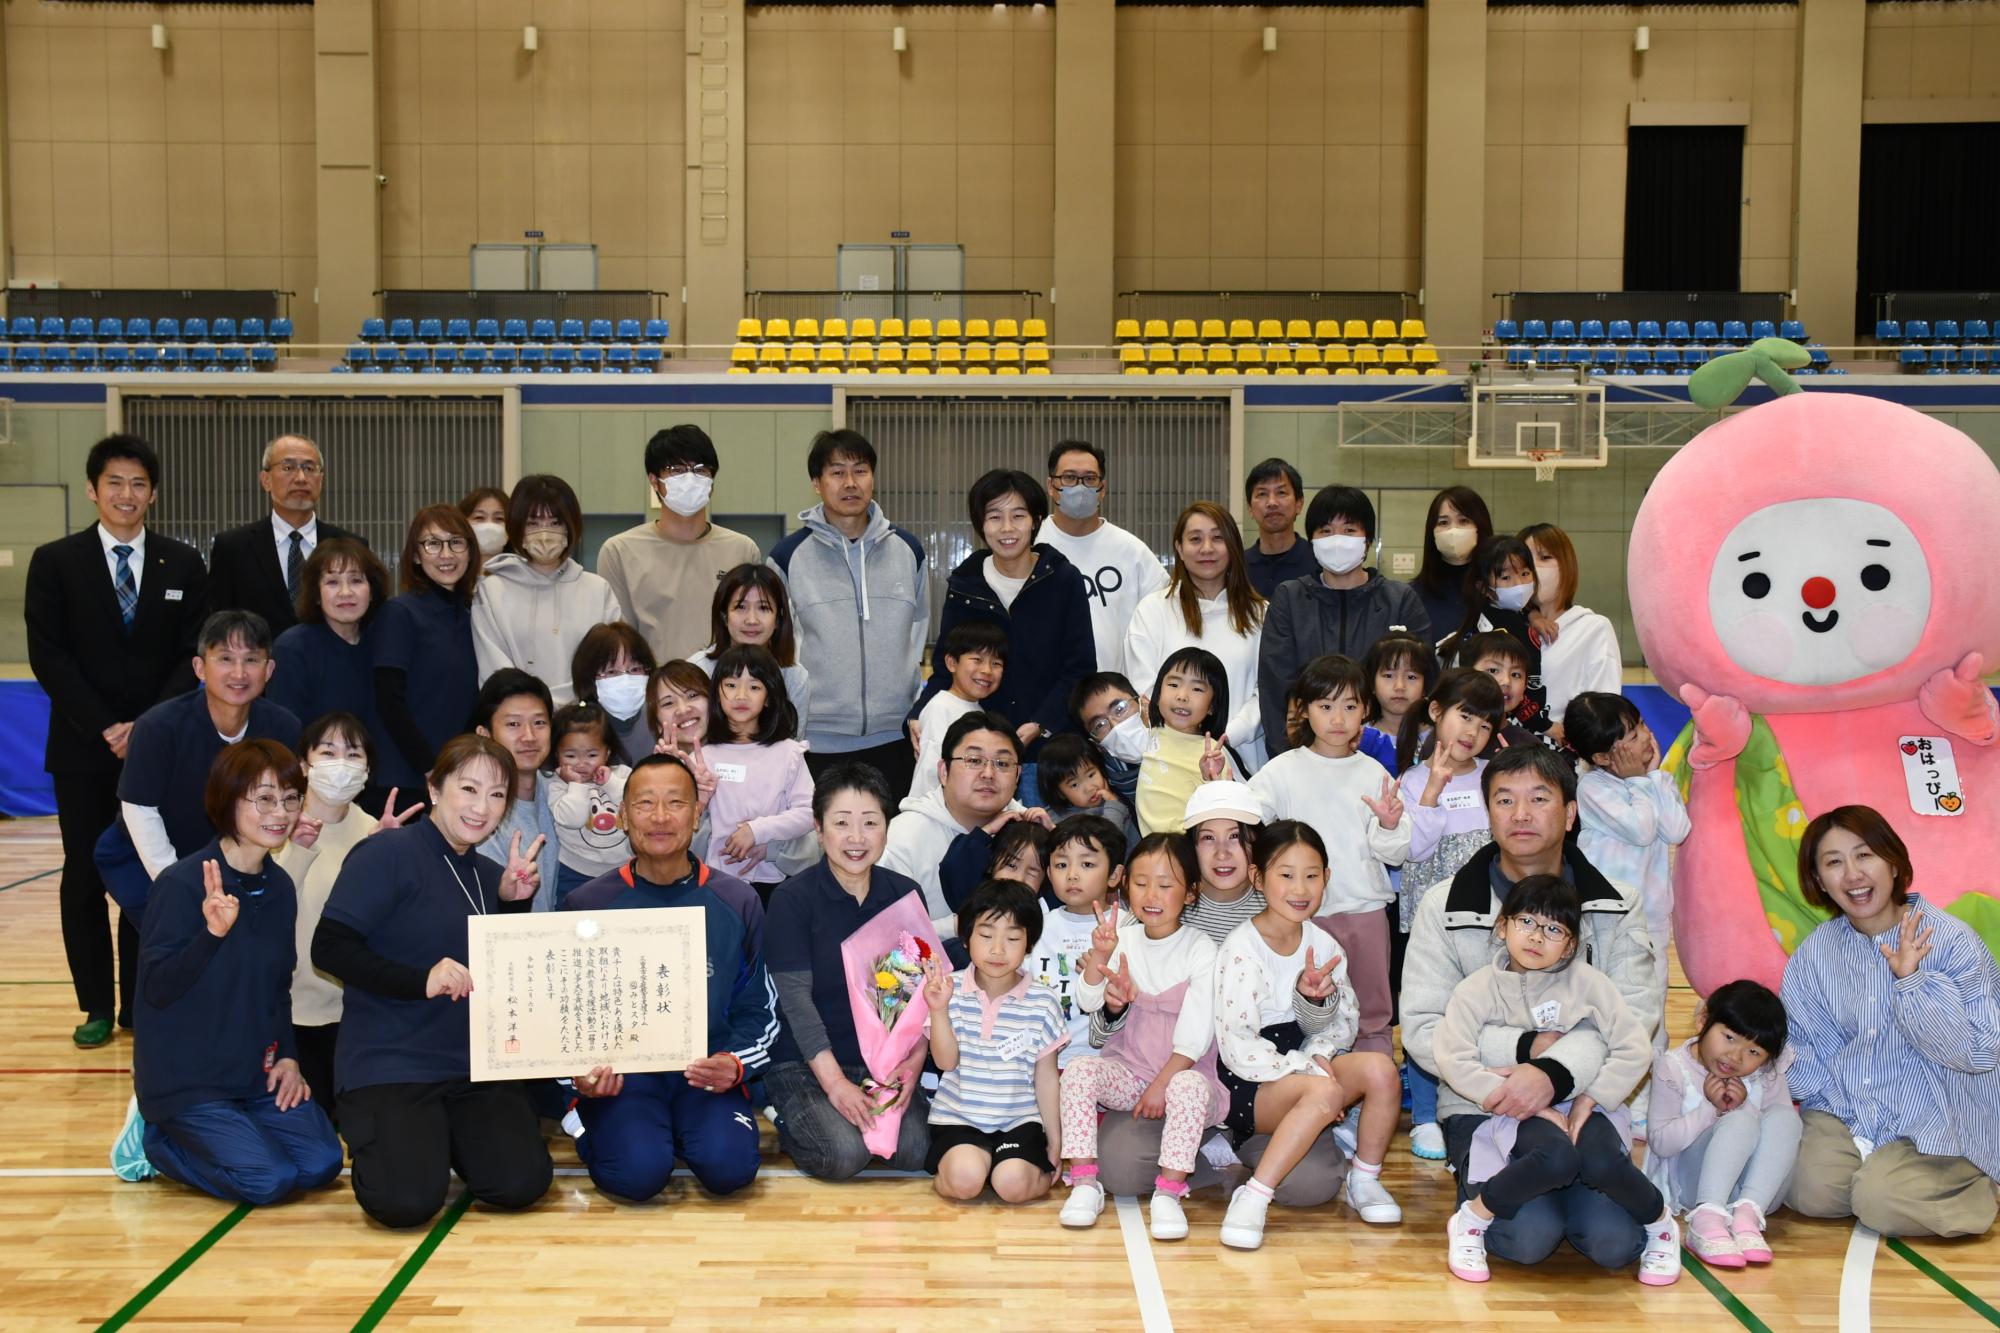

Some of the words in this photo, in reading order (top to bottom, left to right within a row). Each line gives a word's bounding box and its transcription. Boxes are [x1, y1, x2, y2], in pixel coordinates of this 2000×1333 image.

[1917, 737, 1942, 811] おはっぴー
[545, 949, 556, 1000] 表彰します
[656, 962, 673, 1014] 表彰状
